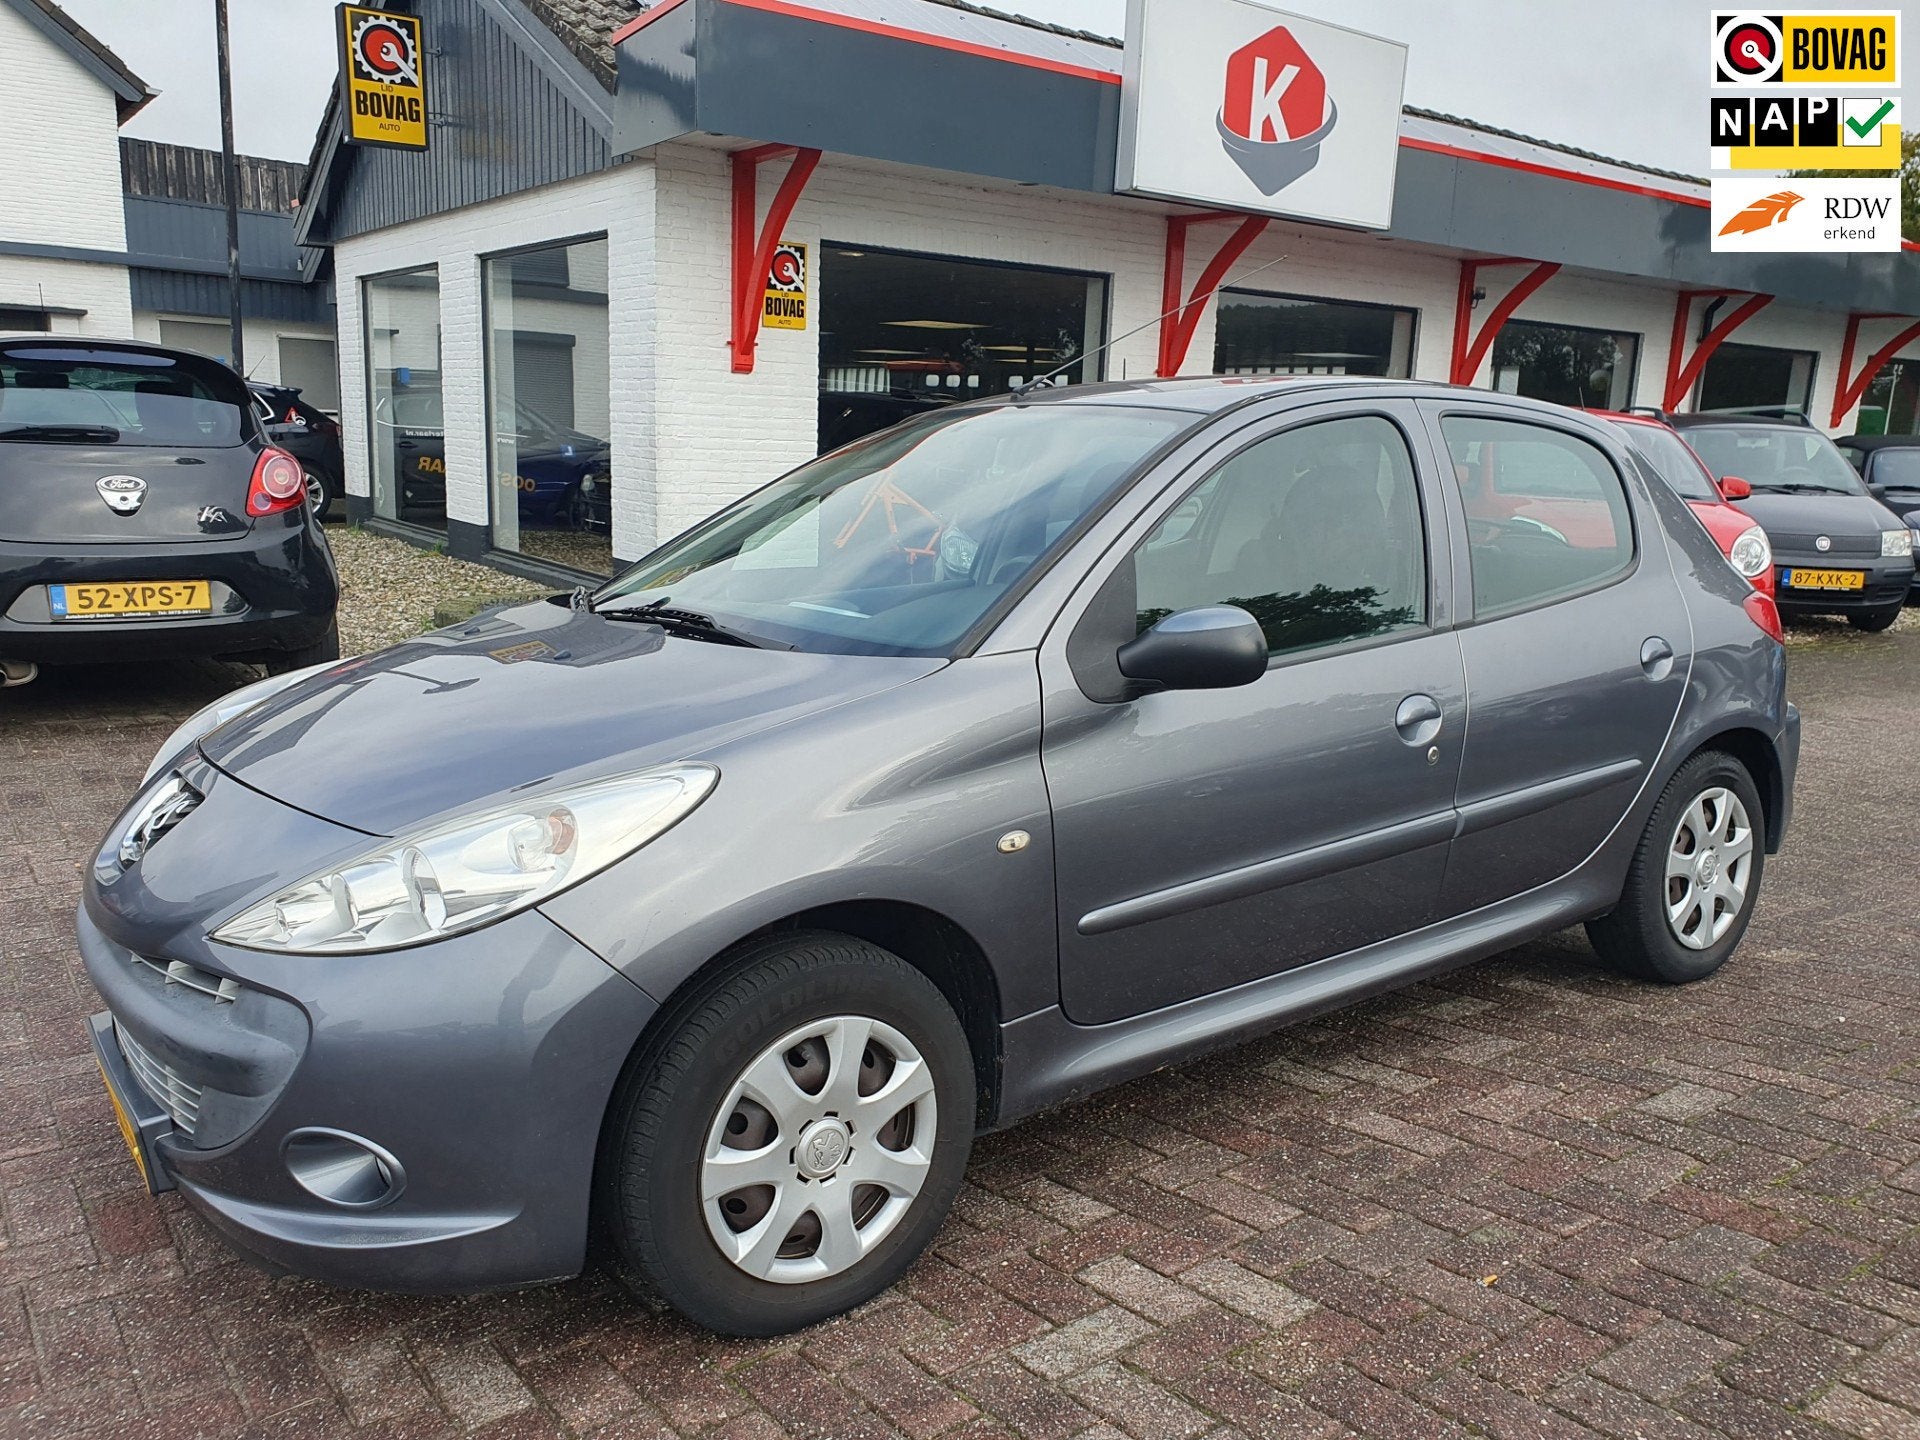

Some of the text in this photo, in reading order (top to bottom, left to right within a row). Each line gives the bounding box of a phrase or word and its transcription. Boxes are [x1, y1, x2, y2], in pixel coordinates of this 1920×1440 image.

[355, 89, 421, 123] BOVAG
[1249, 56, 1301, 142] K
[379, 123, 401, 132] AUTO
[765, 296, 805, 319] BOVAG
[1794, 572, 1858, 586] 87-KXK-2
[53, 602, 66, 610] NL
[77, 585, 197, 610] 52-XPS-7
